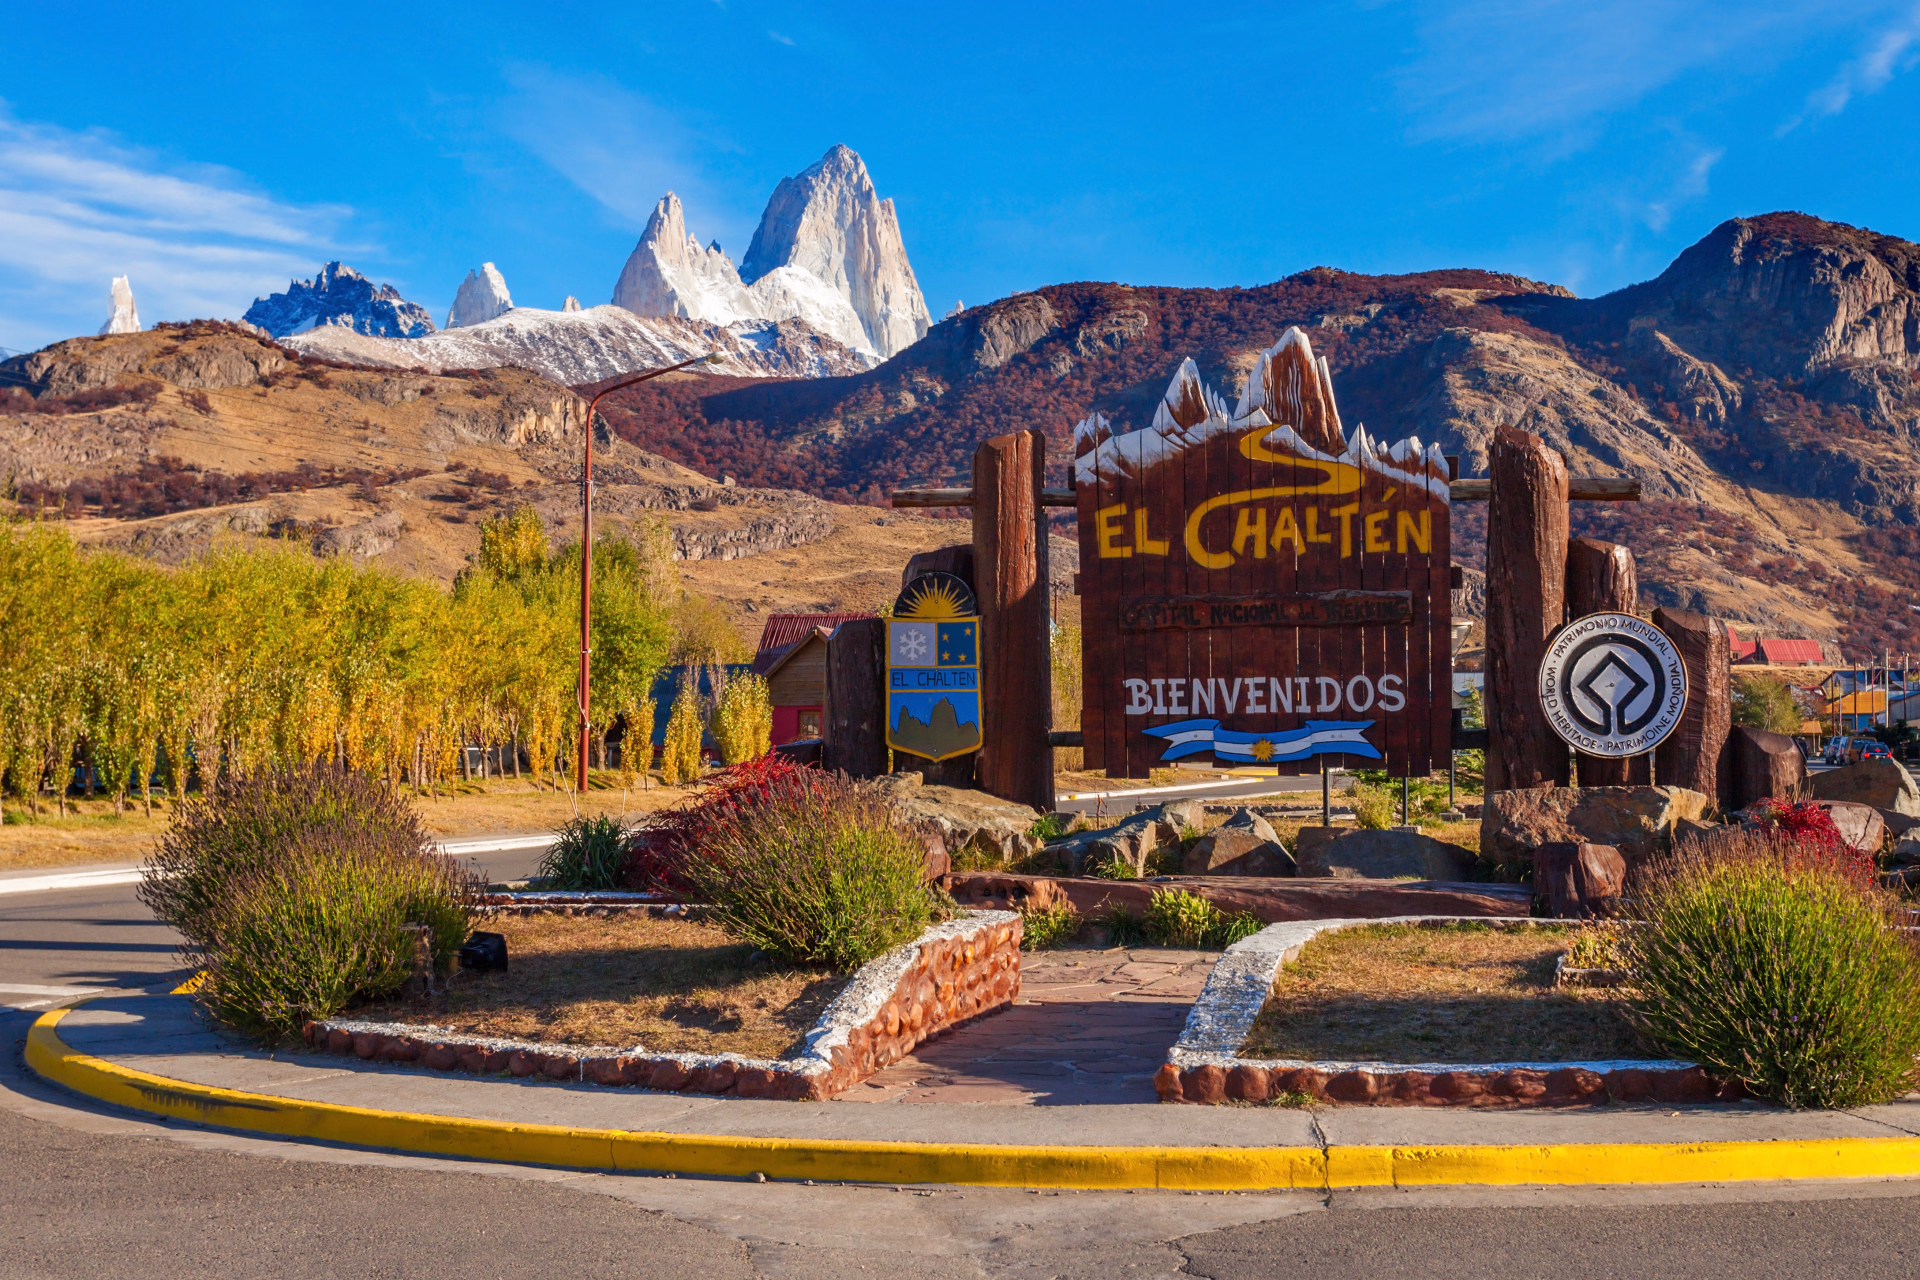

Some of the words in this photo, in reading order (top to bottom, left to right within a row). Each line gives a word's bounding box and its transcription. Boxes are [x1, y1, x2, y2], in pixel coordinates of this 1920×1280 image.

[1094, 503, 1170, 559] EL
[1183, 486, 1432, 570] CHALTÉN
[1553, 617, 1619, 659] PATRIMONIO
[1620, 618, 1672, 657] MUNDIAL
[892, 672, 909, 687] EL
[917, 671, 975, 687] CHALTEN
[1122, 674, 1407, 715] BIENVENIDOS
[1545, 666, 1558, 708] WORLD
[1552, 709, 1598, 750] HERITAGE
[1607, 716, 1672, 752] PATRIMOINE
[1665, 658, 1685, 718] MONDIAL
